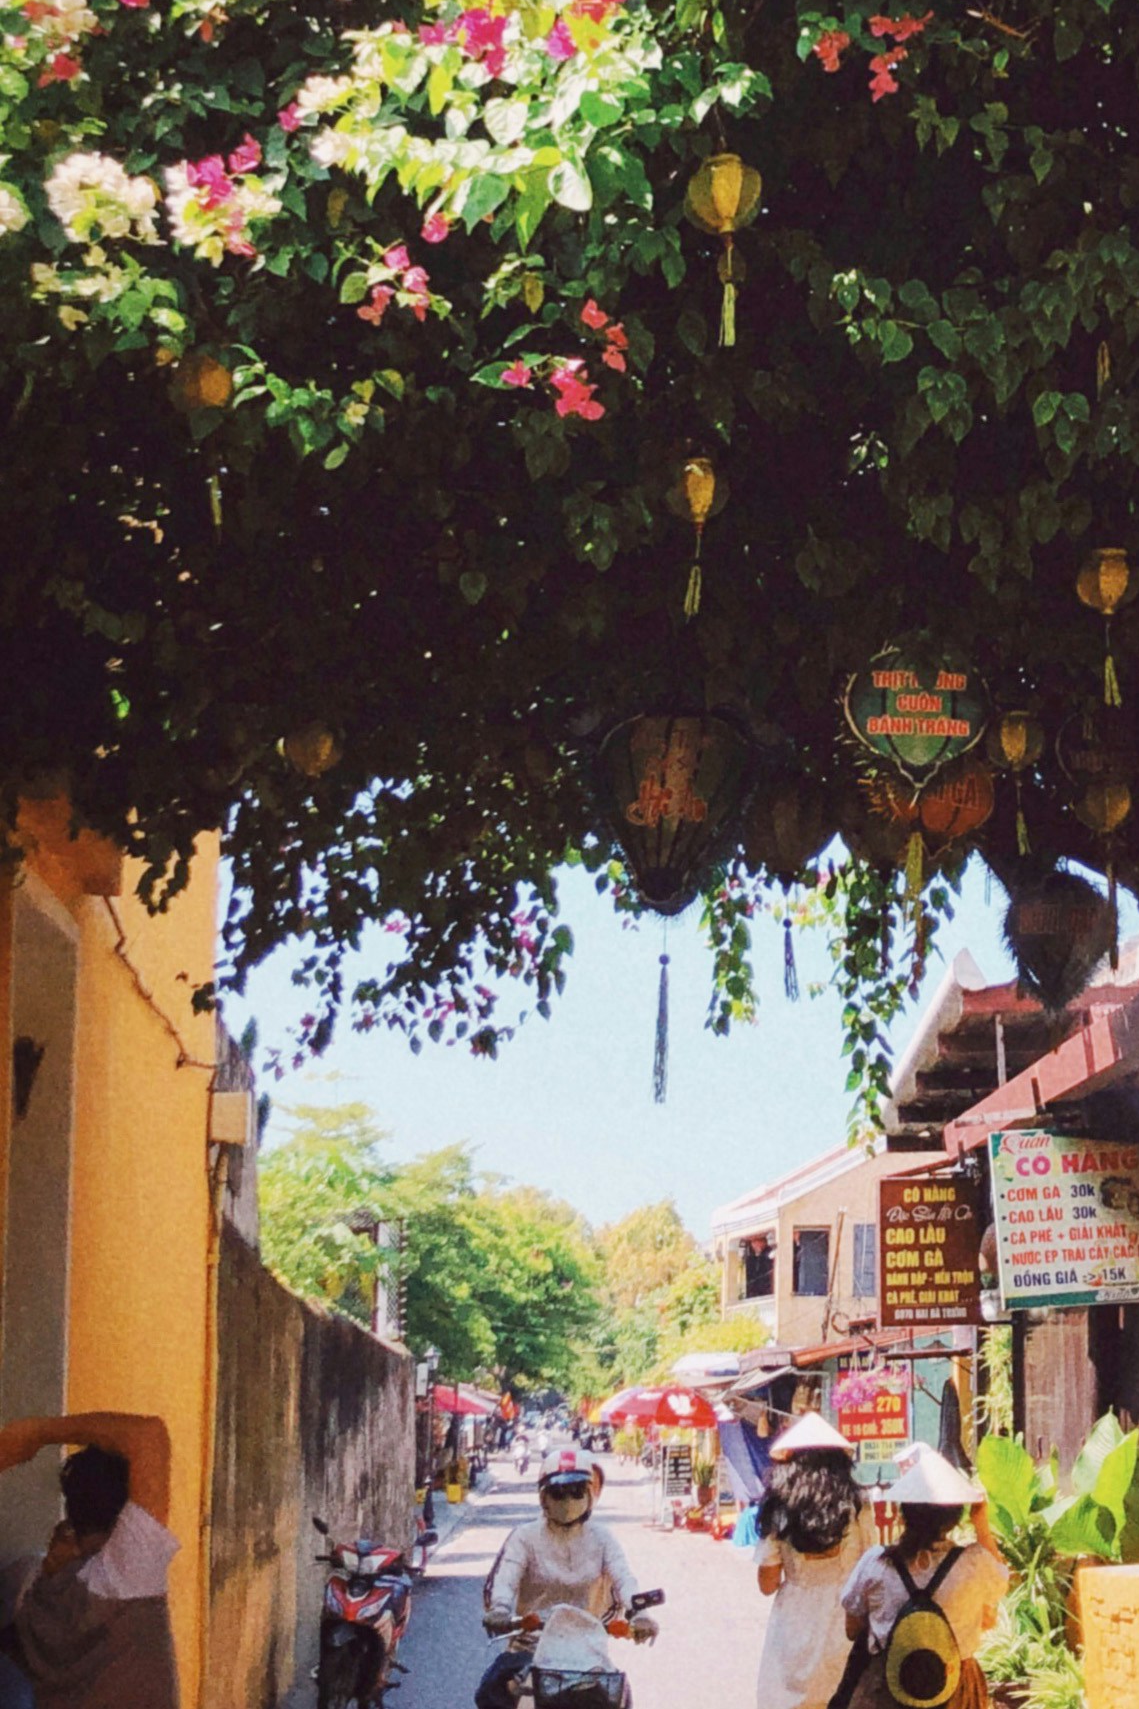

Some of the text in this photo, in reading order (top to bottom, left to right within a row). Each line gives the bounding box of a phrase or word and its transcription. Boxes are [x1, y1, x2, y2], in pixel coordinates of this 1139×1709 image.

[1016, 1150, 1052, 1177] CÔ
[1008, 1209, 1035, 1225] CAO
[885, 1228, 915, 1245] CAO
